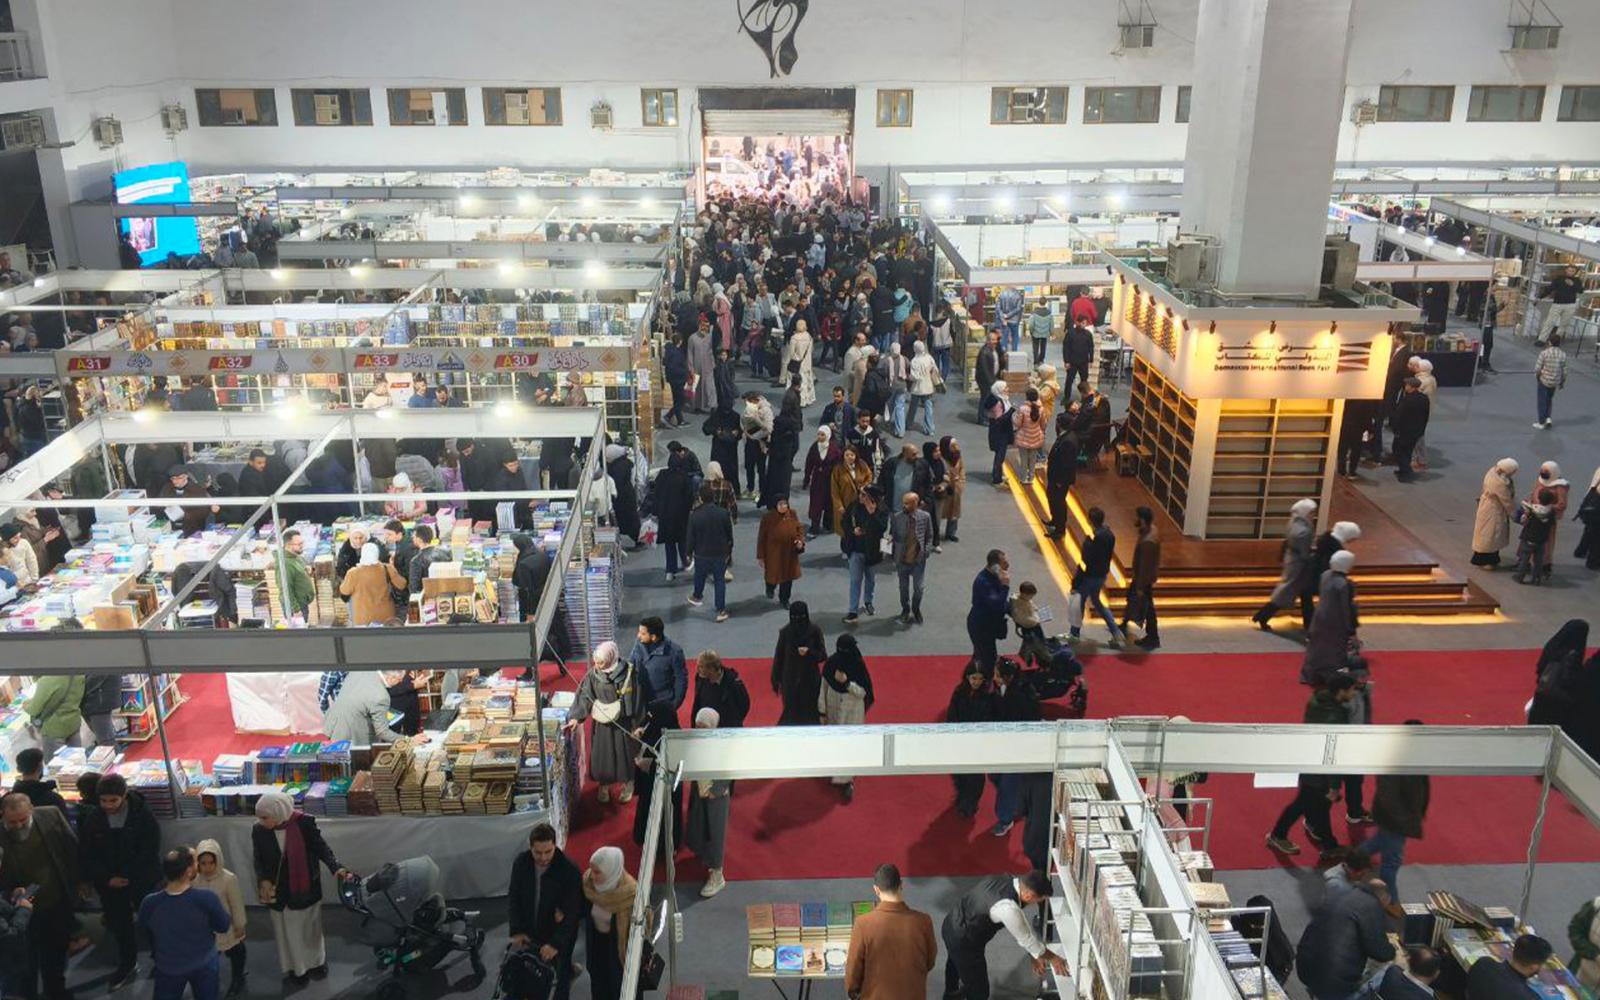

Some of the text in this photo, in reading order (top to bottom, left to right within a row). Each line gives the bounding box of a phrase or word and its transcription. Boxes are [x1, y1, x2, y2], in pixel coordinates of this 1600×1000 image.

[77, 358, 101, 369] A31
[218, 357, 243, 368] A32
[364, 356, 389, 366] A33
[504, 355, 529, 366] A30
